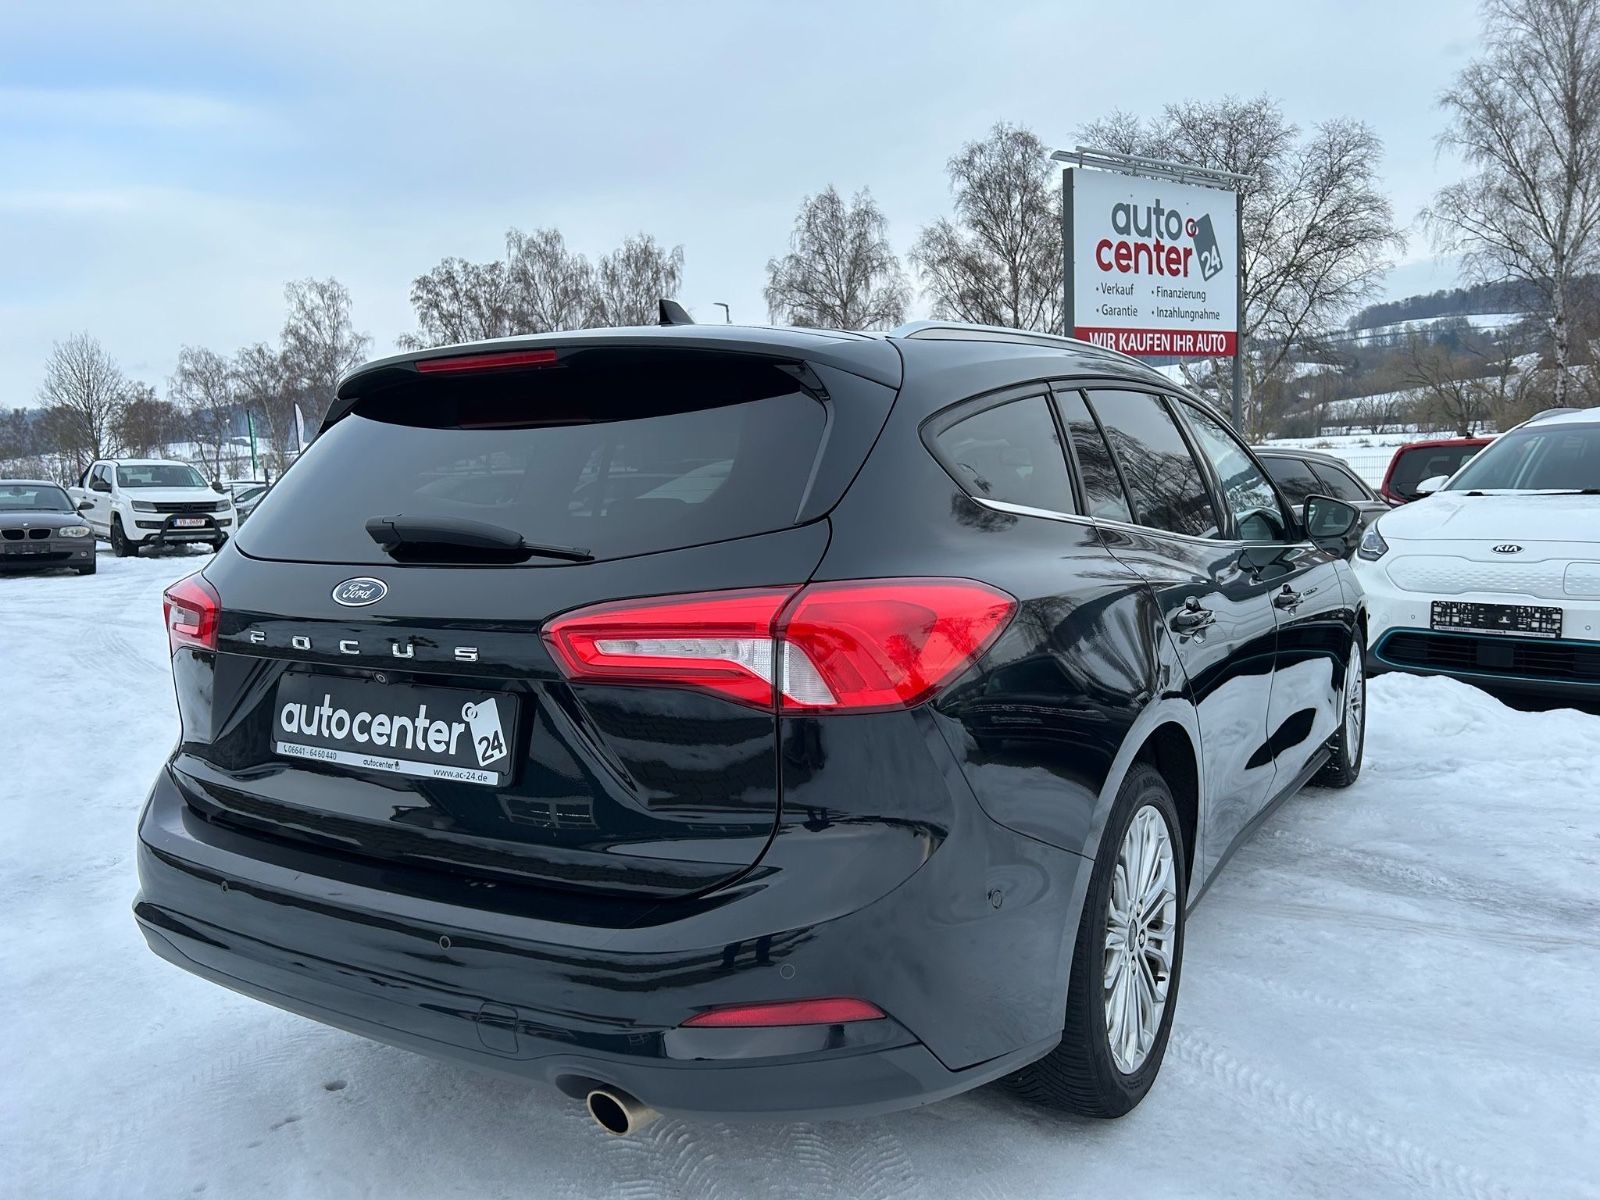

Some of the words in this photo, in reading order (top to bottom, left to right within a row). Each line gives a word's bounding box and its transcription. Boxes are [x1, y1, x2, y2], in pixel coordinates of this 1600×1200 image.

[1112, 199, 1182, 241] auto
[1096, 238, 1192, 277] center
[1200, 245, 1221, 278] 24
[1101, 282, 1134, 296] Verkauf
[1156, 286, 1206, 303] Finanzierung
[1101, 304, 1138, 317] Garantie
[1156, 307, 1220, 322] Inzahlungnahme
[1089, 332, 1116, 350] WIR
[1119, 333, 1170, 351] KAUFEN
[1173, 334, 1194, 352] IHR
[1196, 334, 1227, 352] AUTO
[342, 582, 372, 600] Ford
[250, 631, 479, 662] FOCUS
[280, 694, 465, 755] autocenter
[478, 731, 503, 762] 24
[362, 758, 393, 769] autocenter
[433, 769, 488, 782] www.ac-24.de
